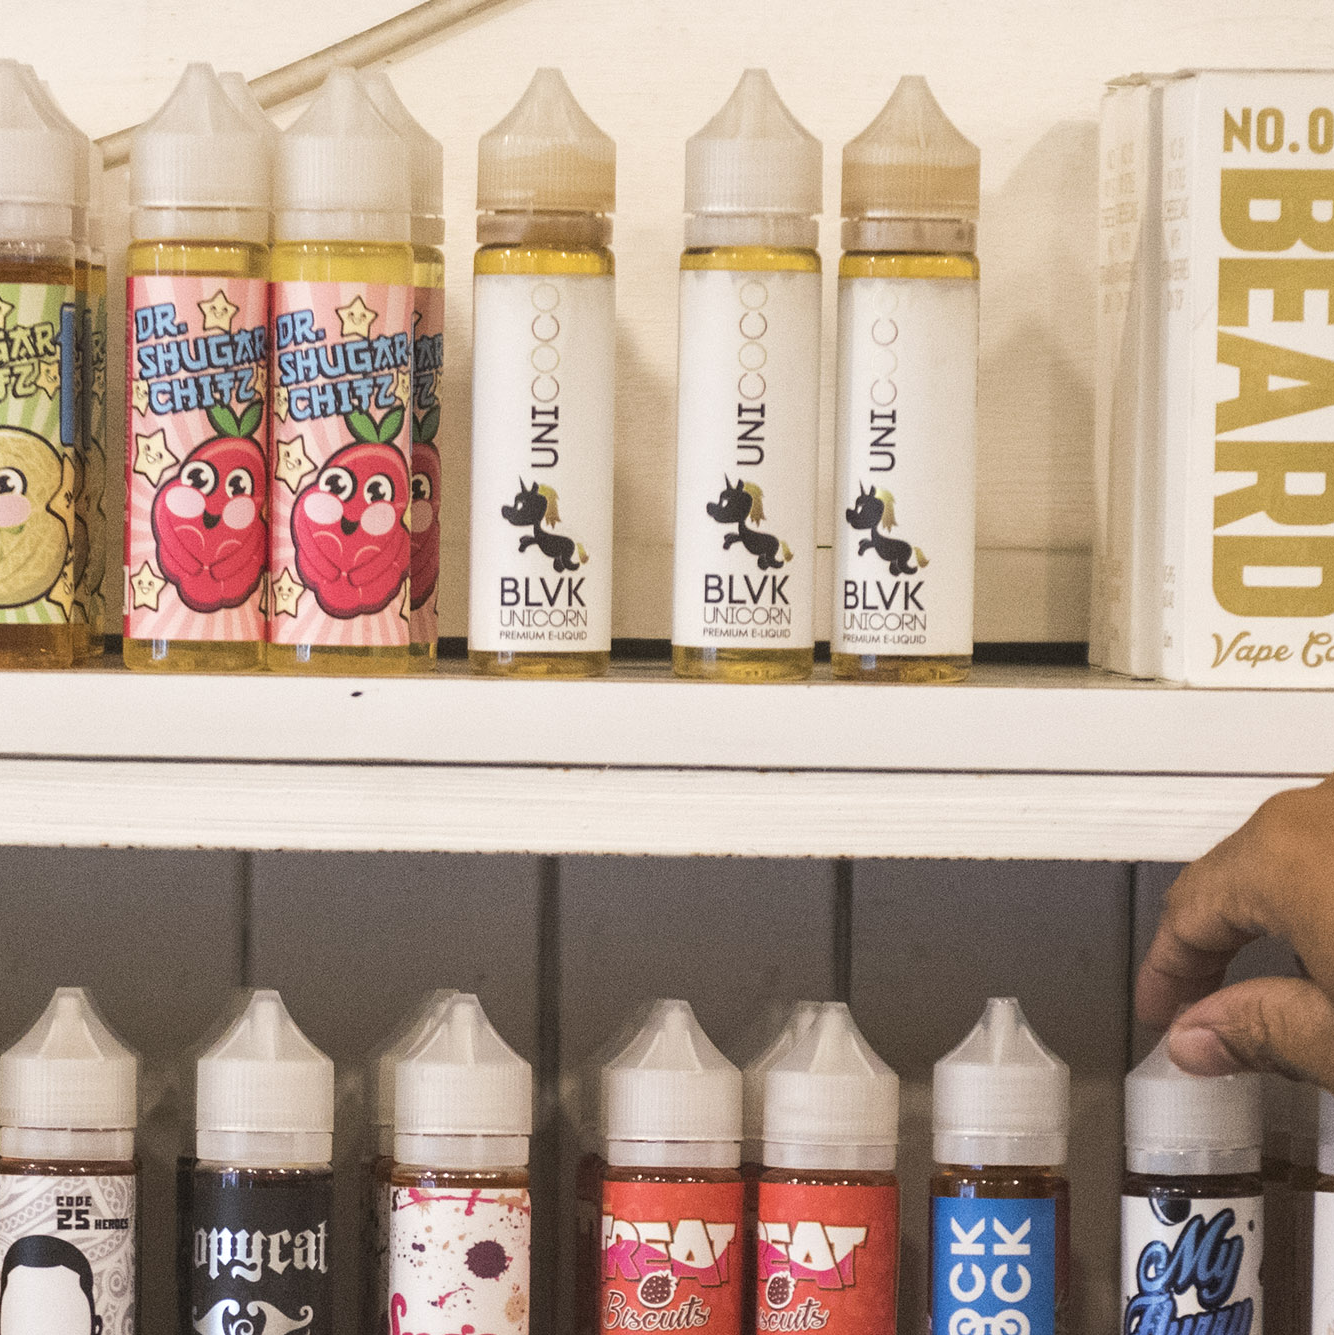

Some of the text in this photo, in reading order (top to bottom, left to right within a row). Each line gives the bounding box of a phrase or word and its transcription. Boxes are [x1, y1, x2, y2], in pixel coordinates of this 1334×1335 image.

[135, 303, 189, 343] DR.
[276, 310, 326, 350] DR.
[138, 328, 267, 380] SHUGAR
[279, 332, 411, 385] SHUGAR
[148, 368, 257, 416] CHITZ
[287, 372, 400, 422] CHITZ
[499, 577, 587, 608] BLVK
[703, 575, 790, 606] BLVK
[844, 580, 925, 612] BLVK
[499, 609, 588, 628] UNICORN
[703, 606, 792, 625] UNICORN
[844, 612, 927, 632] UNICORN
[499, 629, 587, 641] PREMIUM E-LIQUID
[703, 627, 791, 639] PREMIUM E-LIQUID
[843, 634, 927, 645] PREMIUM E-LIQUID
[1210, 631, 1294, 669] Vape
[56, 1196, 92, 1207] CODE
[57, 1209, 90, 1230] 25
[1137, 1208, 1244, 1308] My
[602, 1289, 711, 1332] Biscuits
